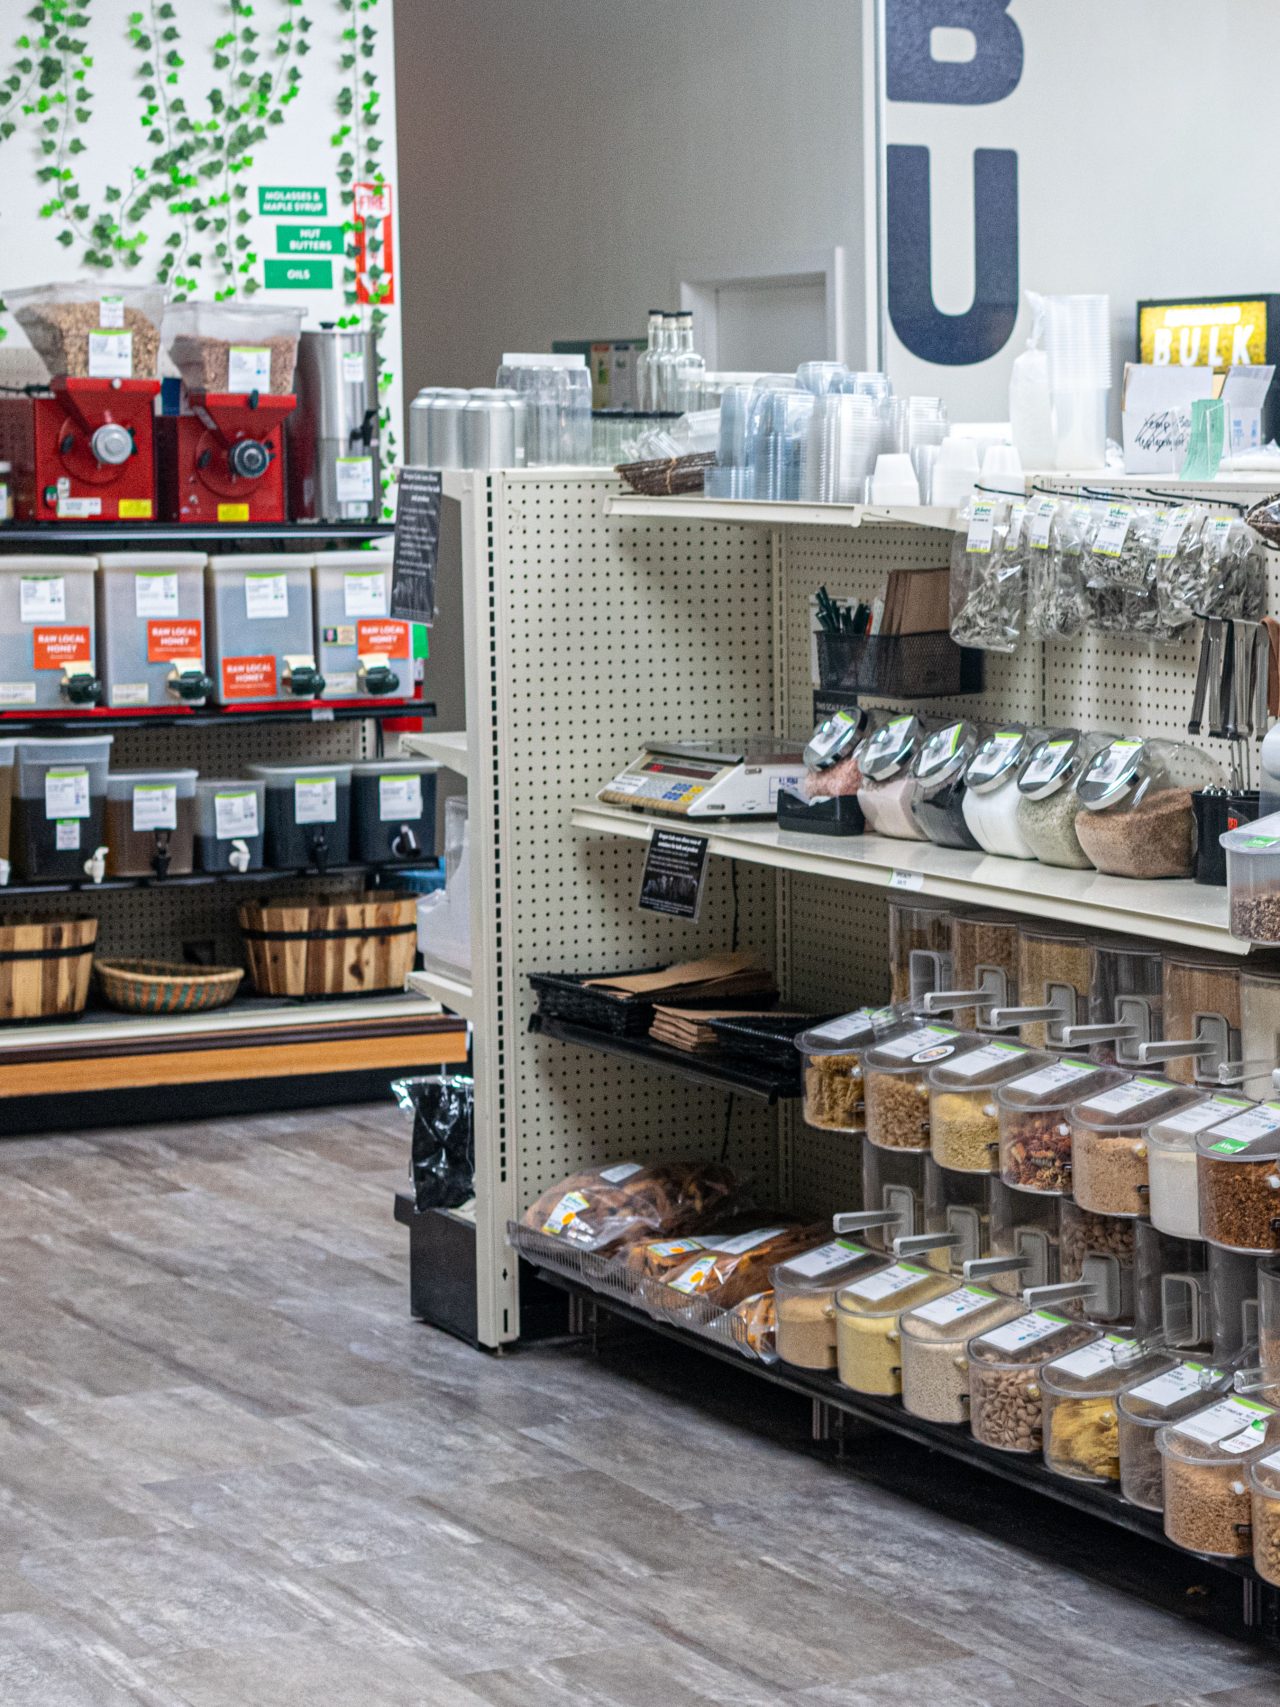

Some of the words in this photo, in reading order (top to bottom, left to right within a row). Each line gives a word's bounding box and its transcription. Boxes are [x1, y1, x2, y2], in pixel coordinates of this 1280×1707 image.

[265, 192, 312, 201] MOLASSES
[263, 202, 292, 211] MAPLE
[294, 202, 324, 212] SYRUP
[300, 229, 321, 238] NUT
[289, 241, 332, 251] BUTTERS
[287, 269, 310, 280] OILS
[1152, 324, 1255, 367] BULK
[152, 628, 171, 637] RAW
[172, 628, 197, 637] LOCAL
[361, 626, 379, 635] RAW
[380, 626, 405, 635] LOCAL
[38, 634, 57, 644] RAW
[58, 634, 86, 643] LOCAL
[161, 637, 190, 646] HONEY
[369, 635, 398, 644] HONEY
[47, 644, 77, 654] HONEY
[227, 665, 245, 674] RAW
[246, 664, 272, 672] LOCAL
[236, 673, 265, 683] HONEY
